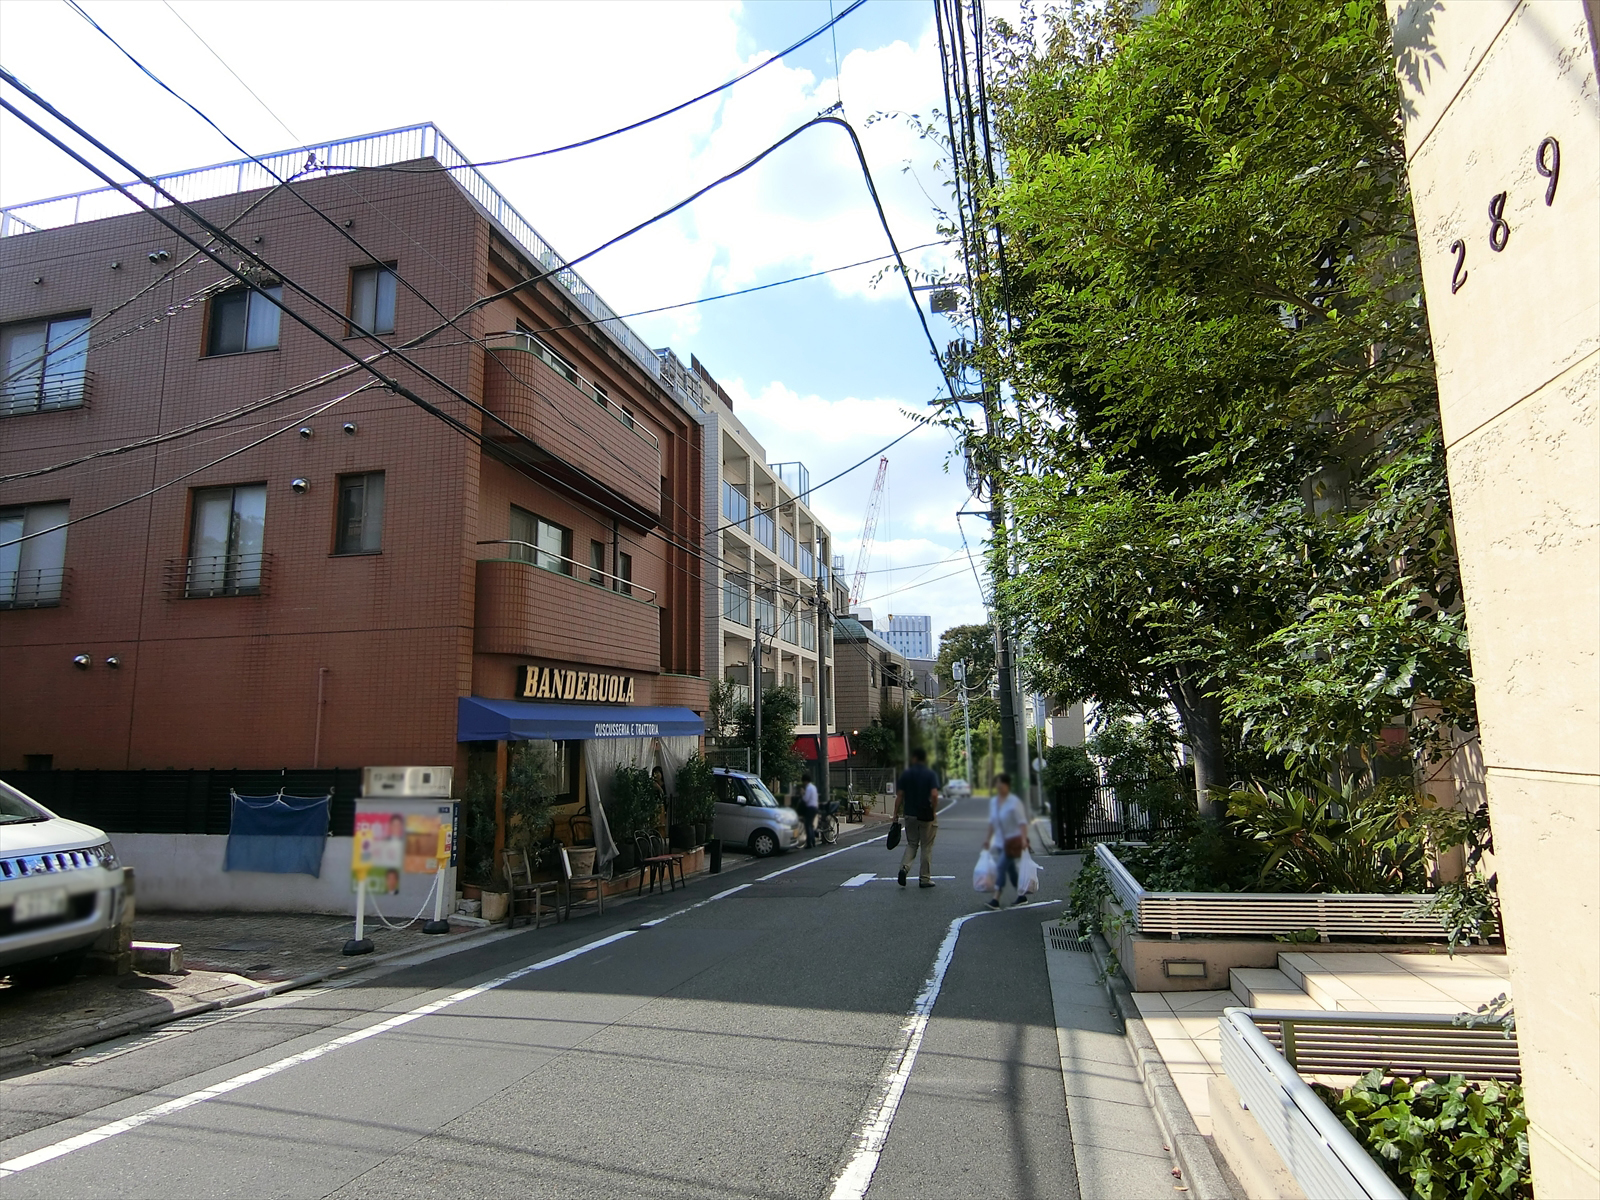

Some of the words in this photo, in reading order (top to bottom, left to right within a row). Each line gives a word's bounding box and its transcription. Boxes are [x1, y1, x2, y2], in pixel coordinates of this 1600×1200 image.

[1450, 136, 1561, 295] 289
[523, 665, 635, 703] BANDERUOLA
[594, 723, 630, 737] CUSCUSSERIA
[630, 723, 635, 736] E
[635, 723, 660, 736] TRATTORIA
